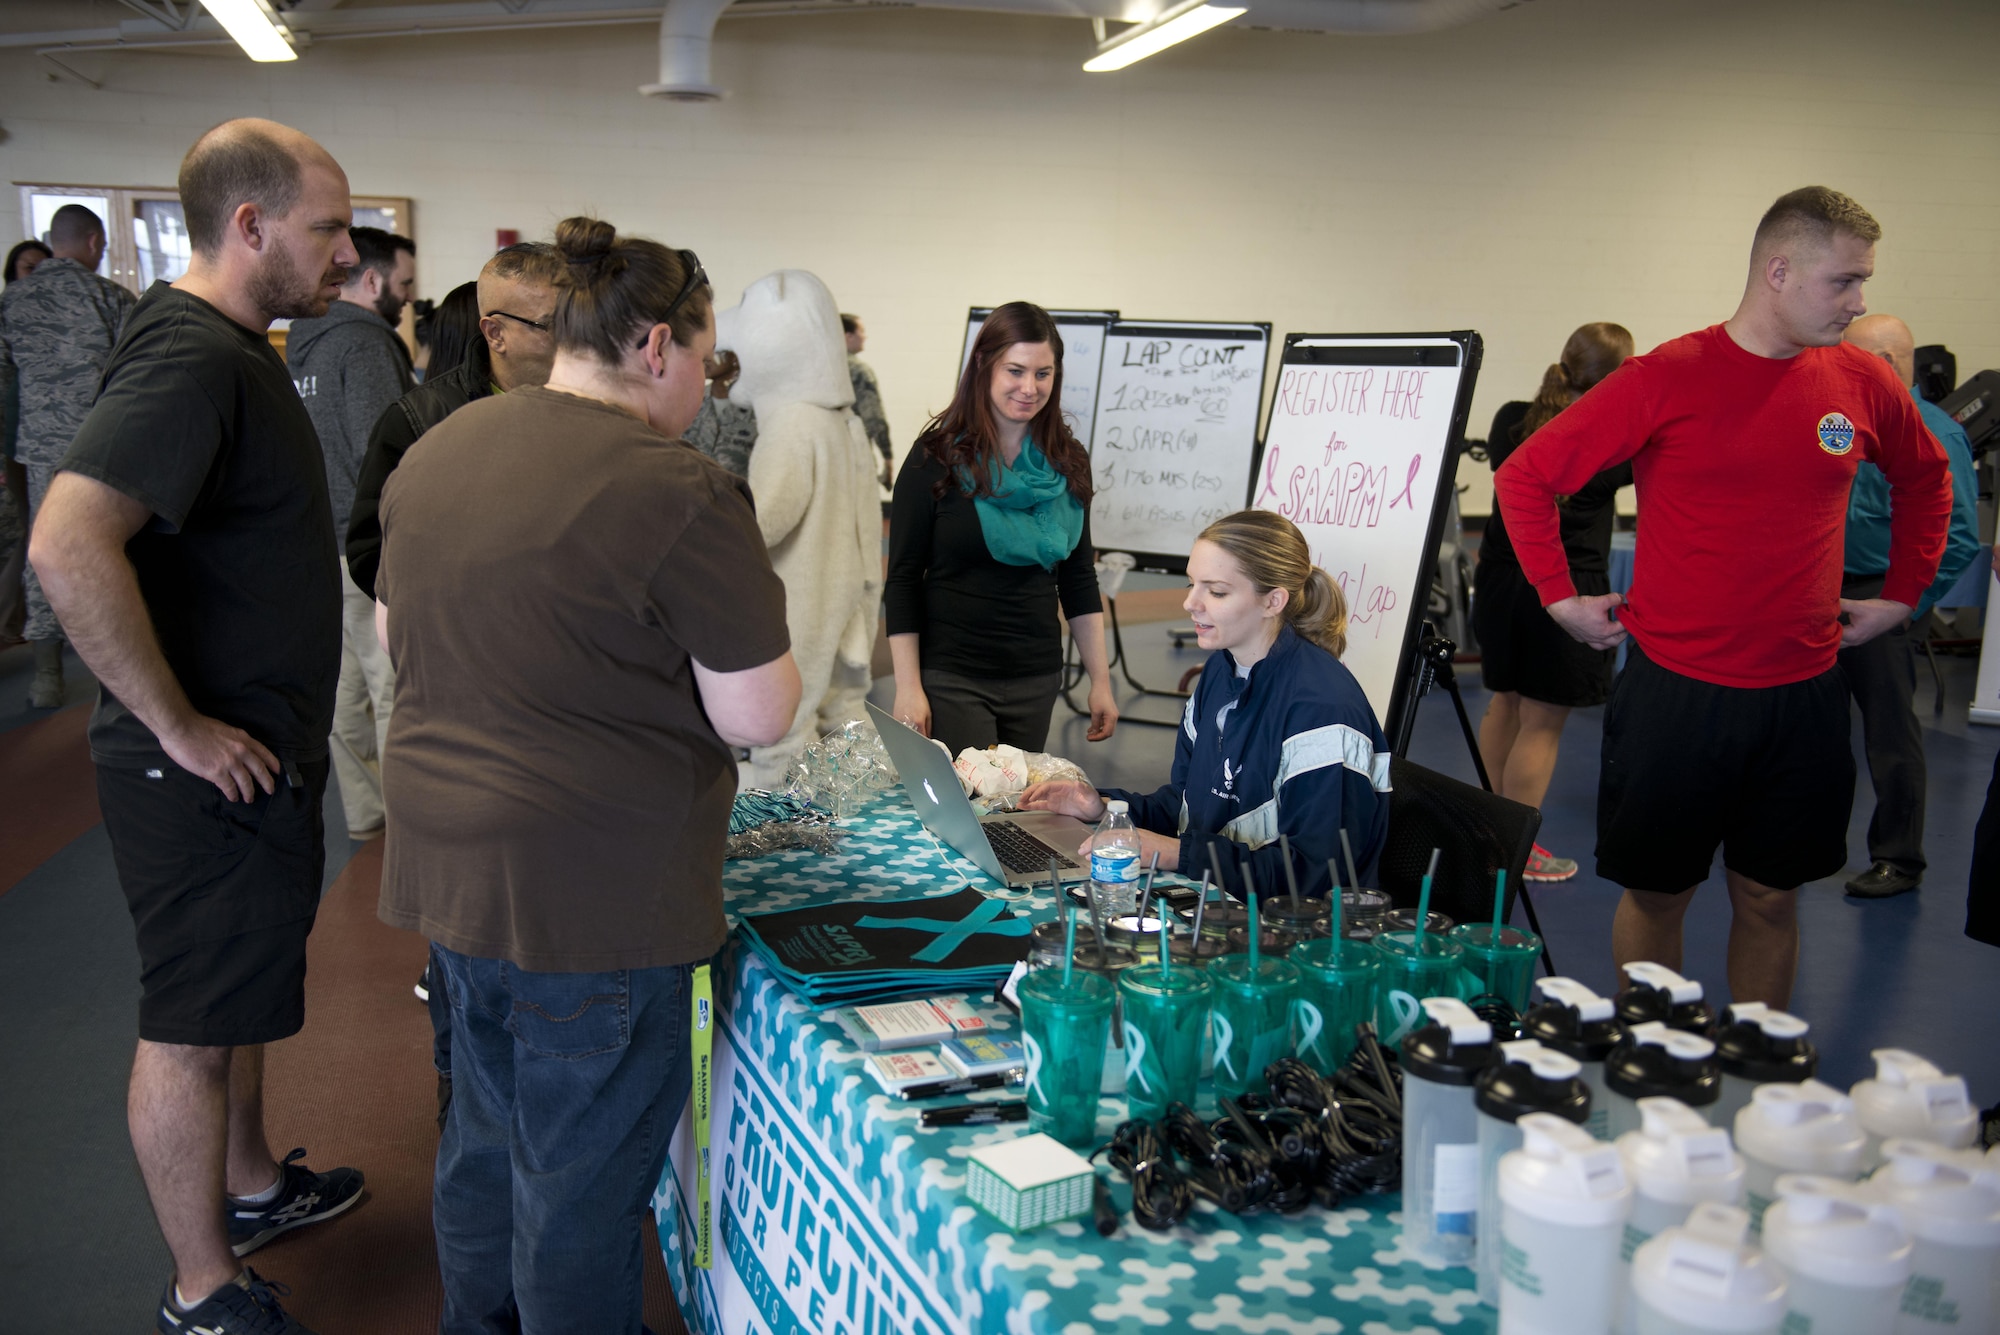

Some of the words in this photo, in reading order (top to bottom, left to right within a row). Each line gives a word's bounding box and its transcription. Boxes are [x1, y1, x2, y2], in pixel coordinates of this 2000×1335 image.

[1122, 341, 1172, 367] LAP
[1178, 344, 1245, 368] COUNT
[1277, 368, 1374, 416] REGISTER
[1380, 370, 1430, 420] HERE
[1127, 425, 1175, 454] SAPR
[1323, 431, 1348, 467] for
[1123, 468, 1153, 488] 176
[1278, 461, 1388, 528] SAAPM
[822, 924, 869, 959] SAPR
[700, 1053, 709, 1121] SEAHAWKS
[724, 1152, 768, 1252] OUR
[721, 1203, 780, 1326] PROTECTS
